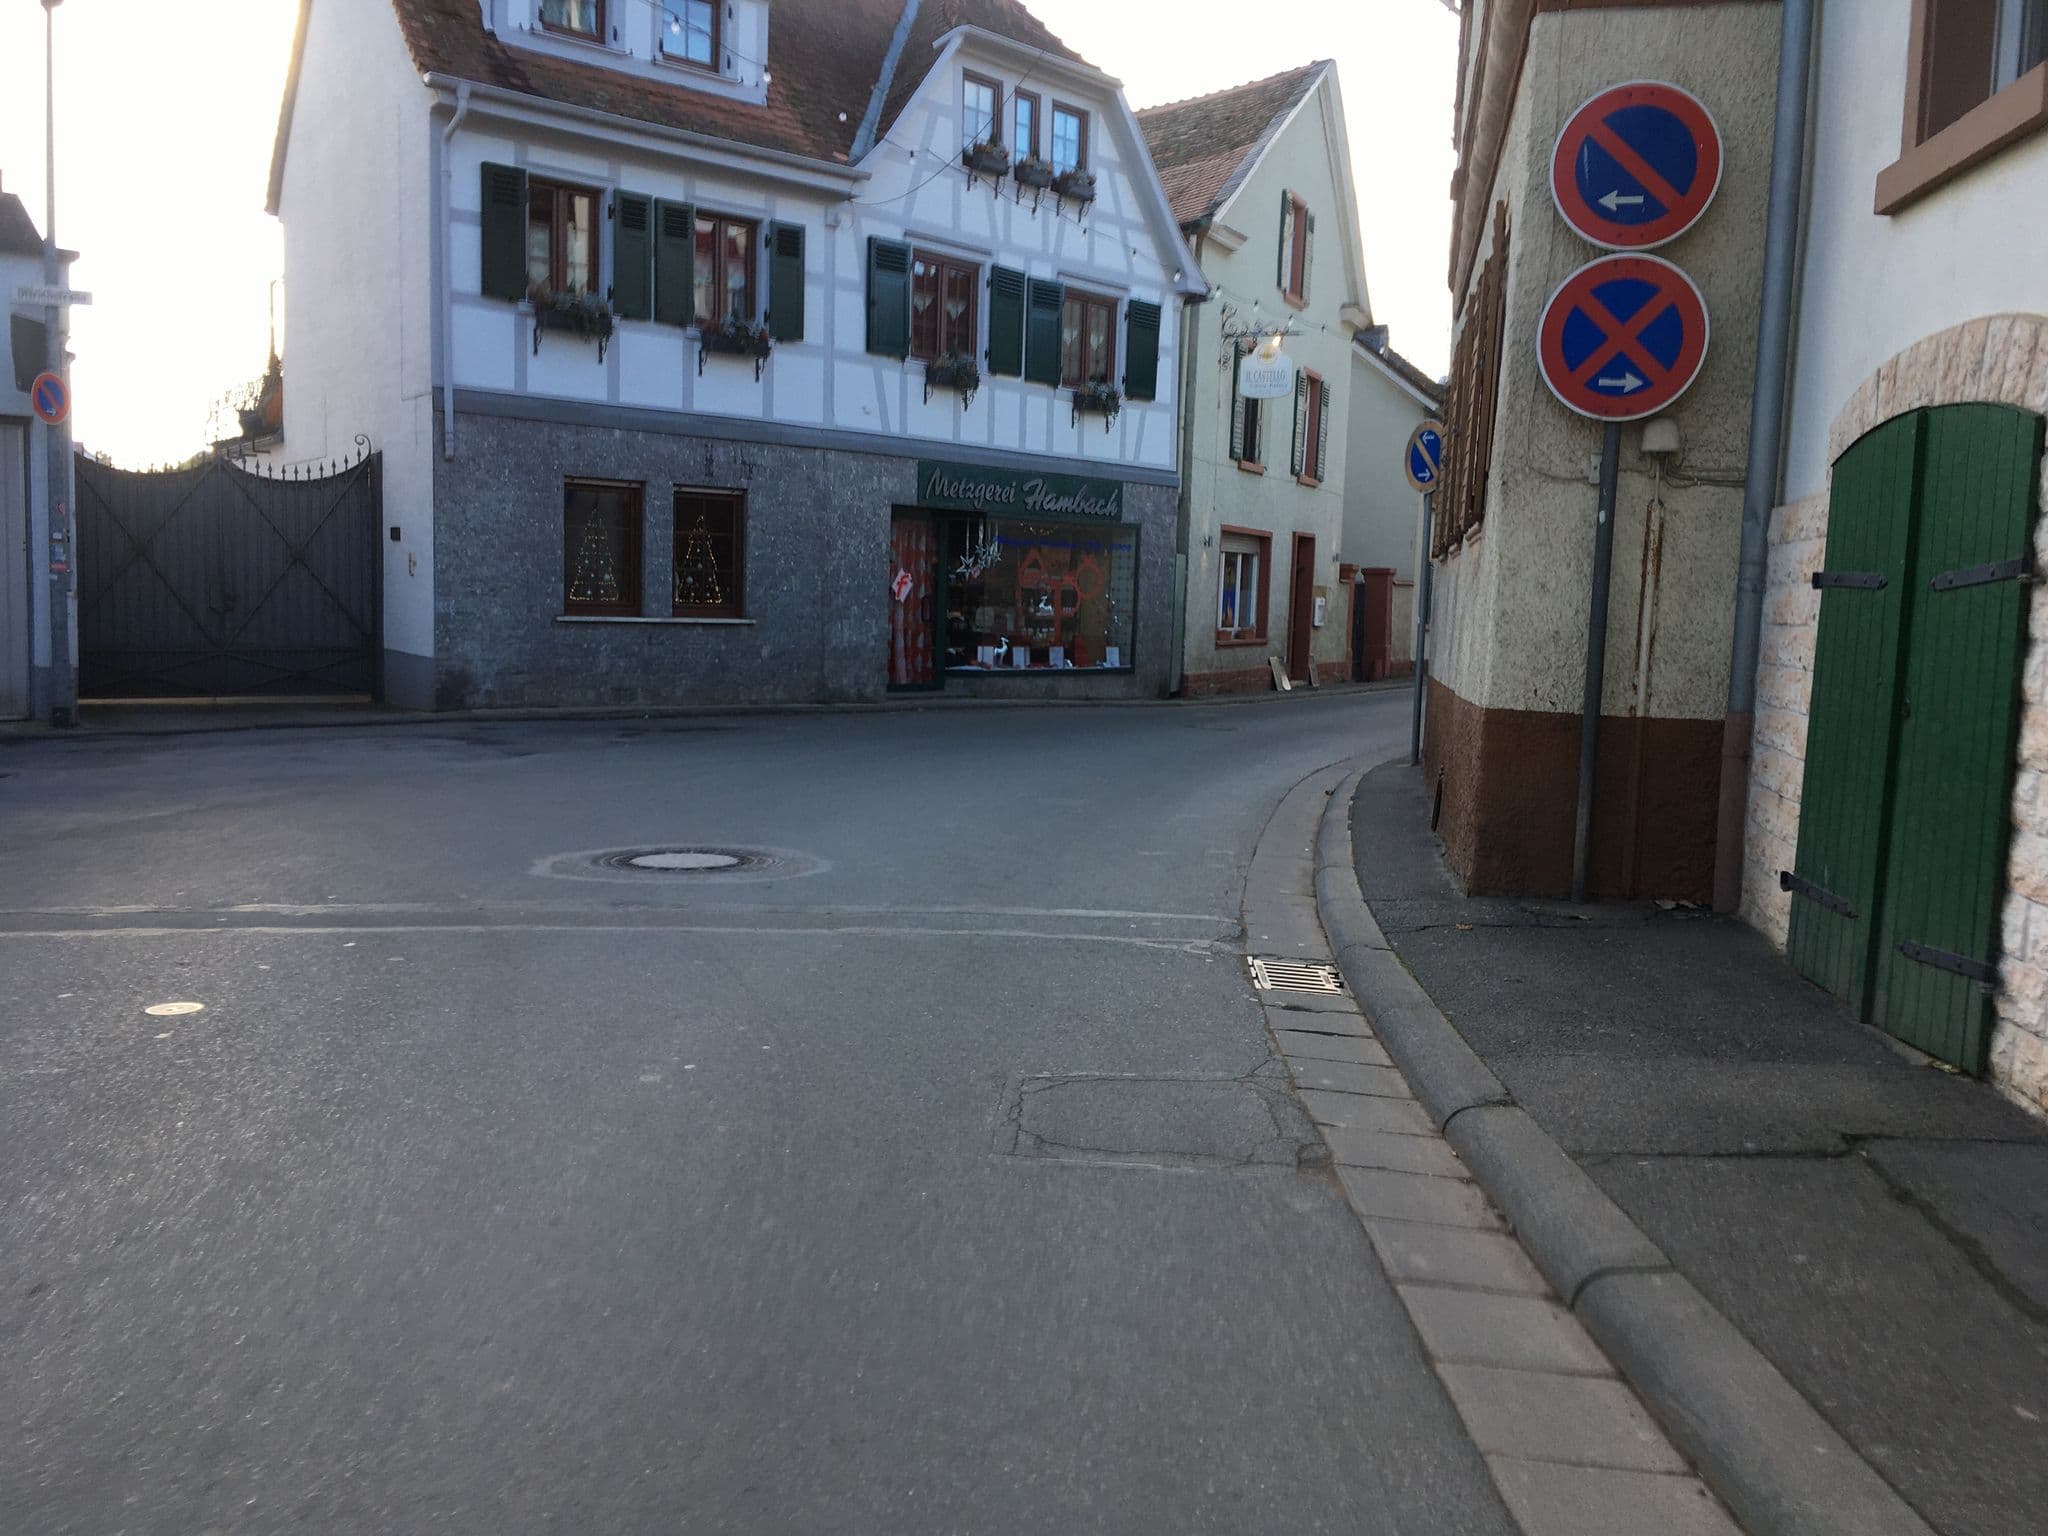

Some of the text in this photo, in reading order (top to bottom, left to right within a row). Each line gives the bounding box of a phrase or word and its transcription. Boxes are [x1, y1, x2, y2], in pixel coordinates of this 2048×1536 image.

[1253, 368, 1287, 384] CASTELLO
[925, 466, 1120, 517] Metzgerei Hambach
